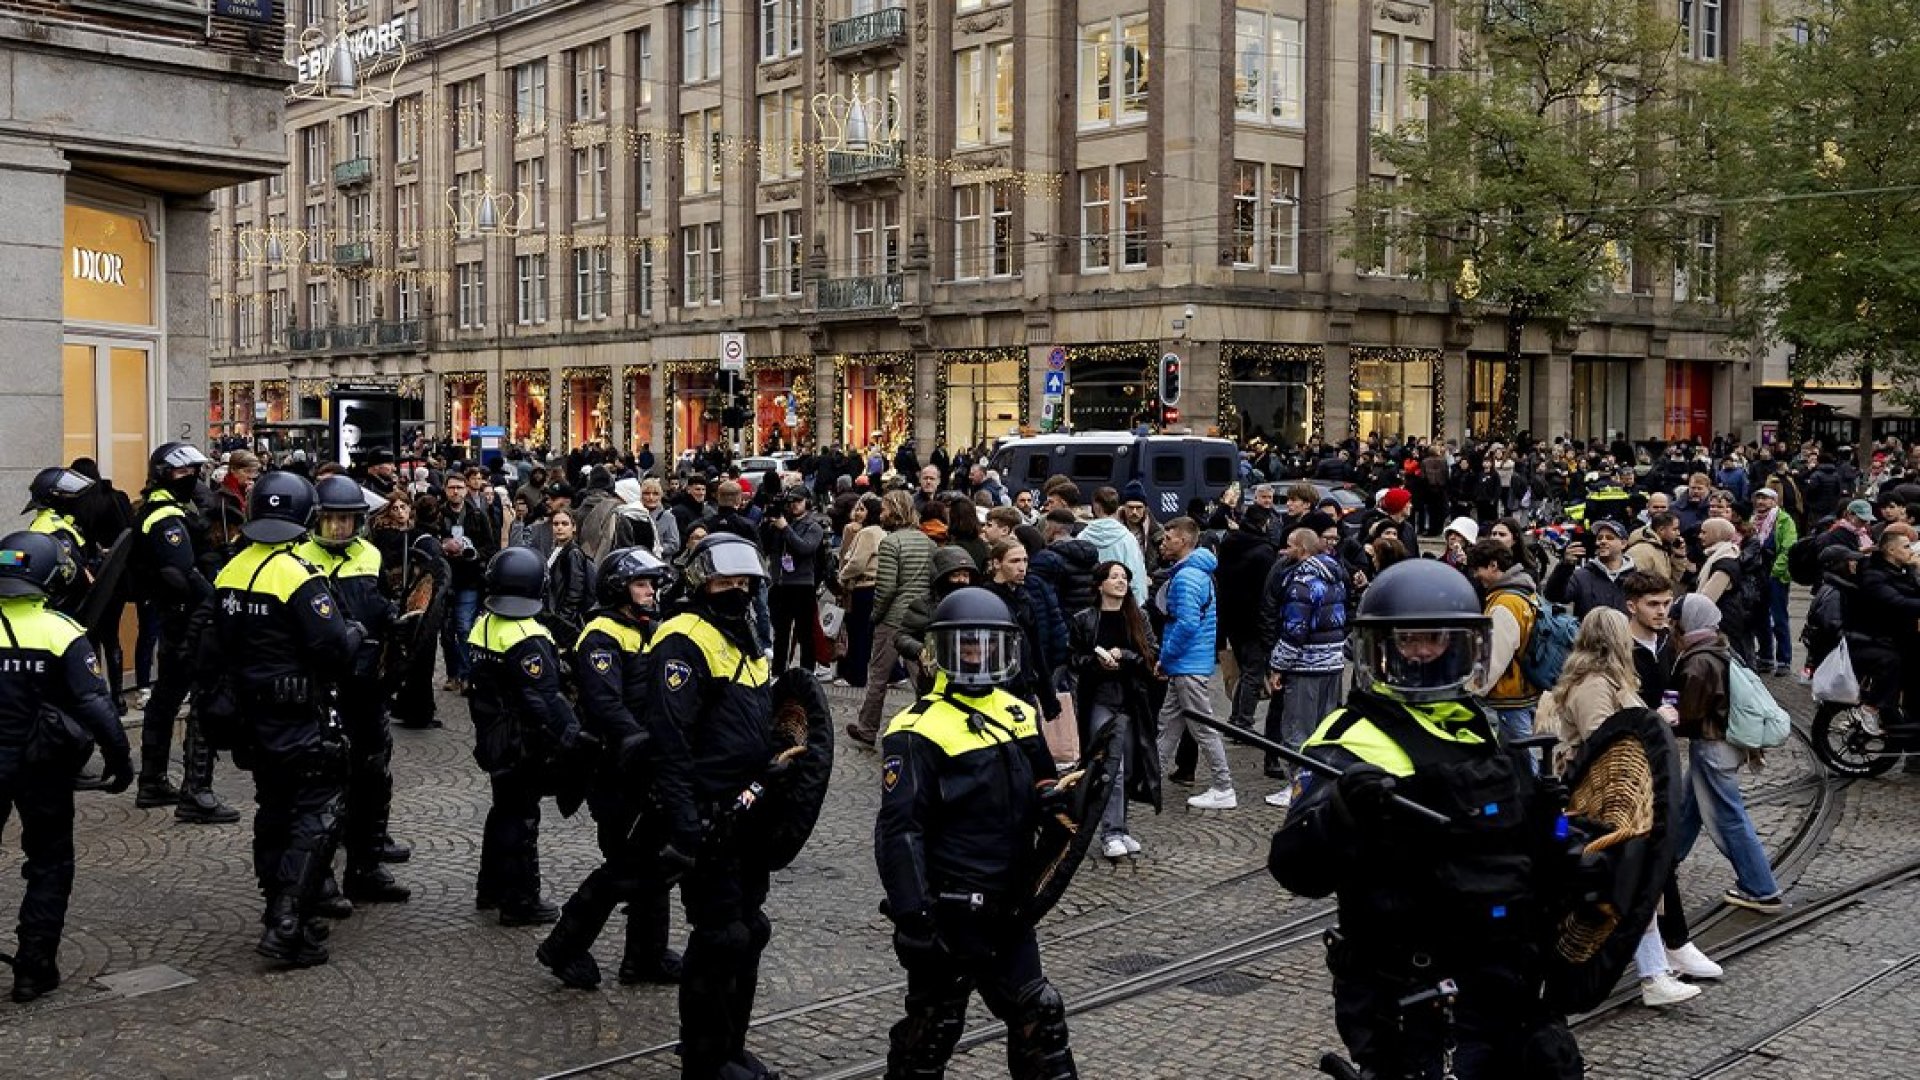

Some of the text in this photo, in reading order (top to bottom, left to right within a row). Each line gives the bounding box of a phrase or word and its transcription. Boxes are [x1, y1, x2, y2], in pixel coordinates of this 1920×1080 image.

[72, 246, 125, 287] DIOR
[180, 422, 191, 440] 2
[269, 494, 280, 507] C
[221, 593, 269, 616] PLTIE
[0, 659, 46, 672] ITIE
